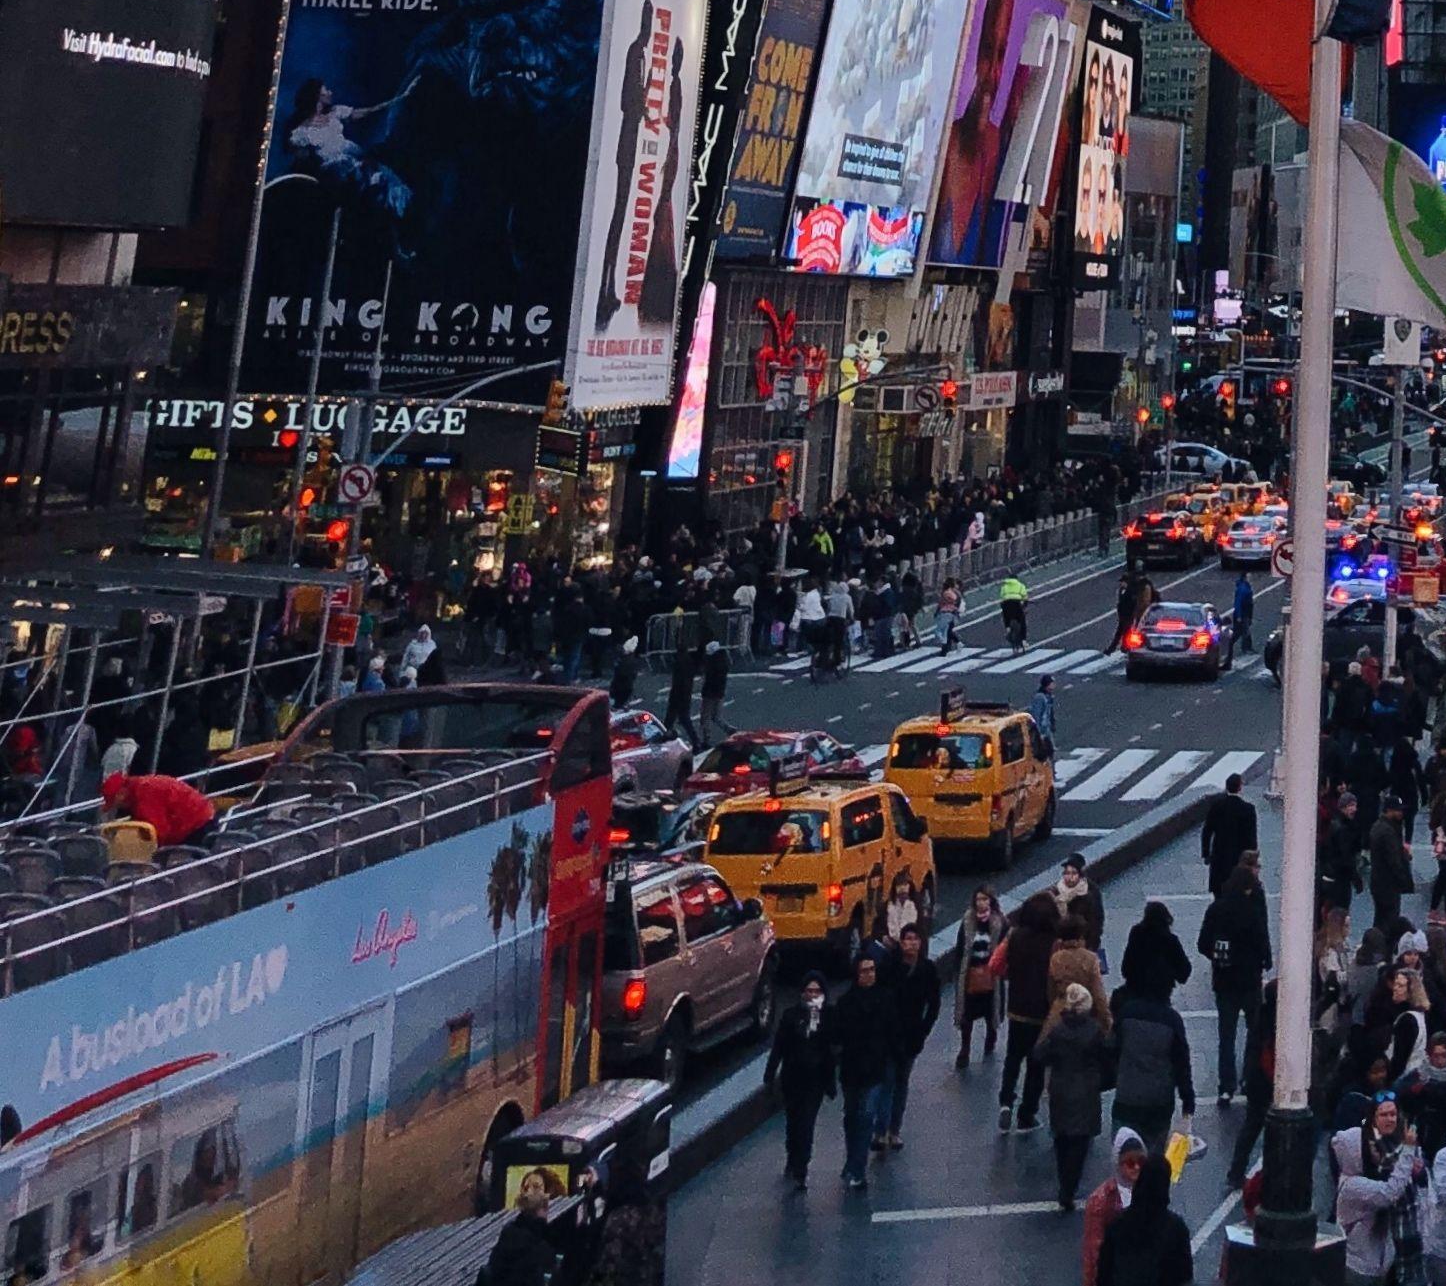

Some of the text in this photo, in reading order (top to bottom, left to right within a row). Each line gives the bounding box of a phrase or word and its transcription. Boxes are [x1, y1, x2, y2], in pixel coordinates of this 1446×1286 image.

[624, 161, 657, 305] WOMAN
[265, 296, 552, 335] KING KONG
[39, 1033, 65, 1091] A
[69, 981, 190, 1081] busload
[196, 963, 227, 1028] of
